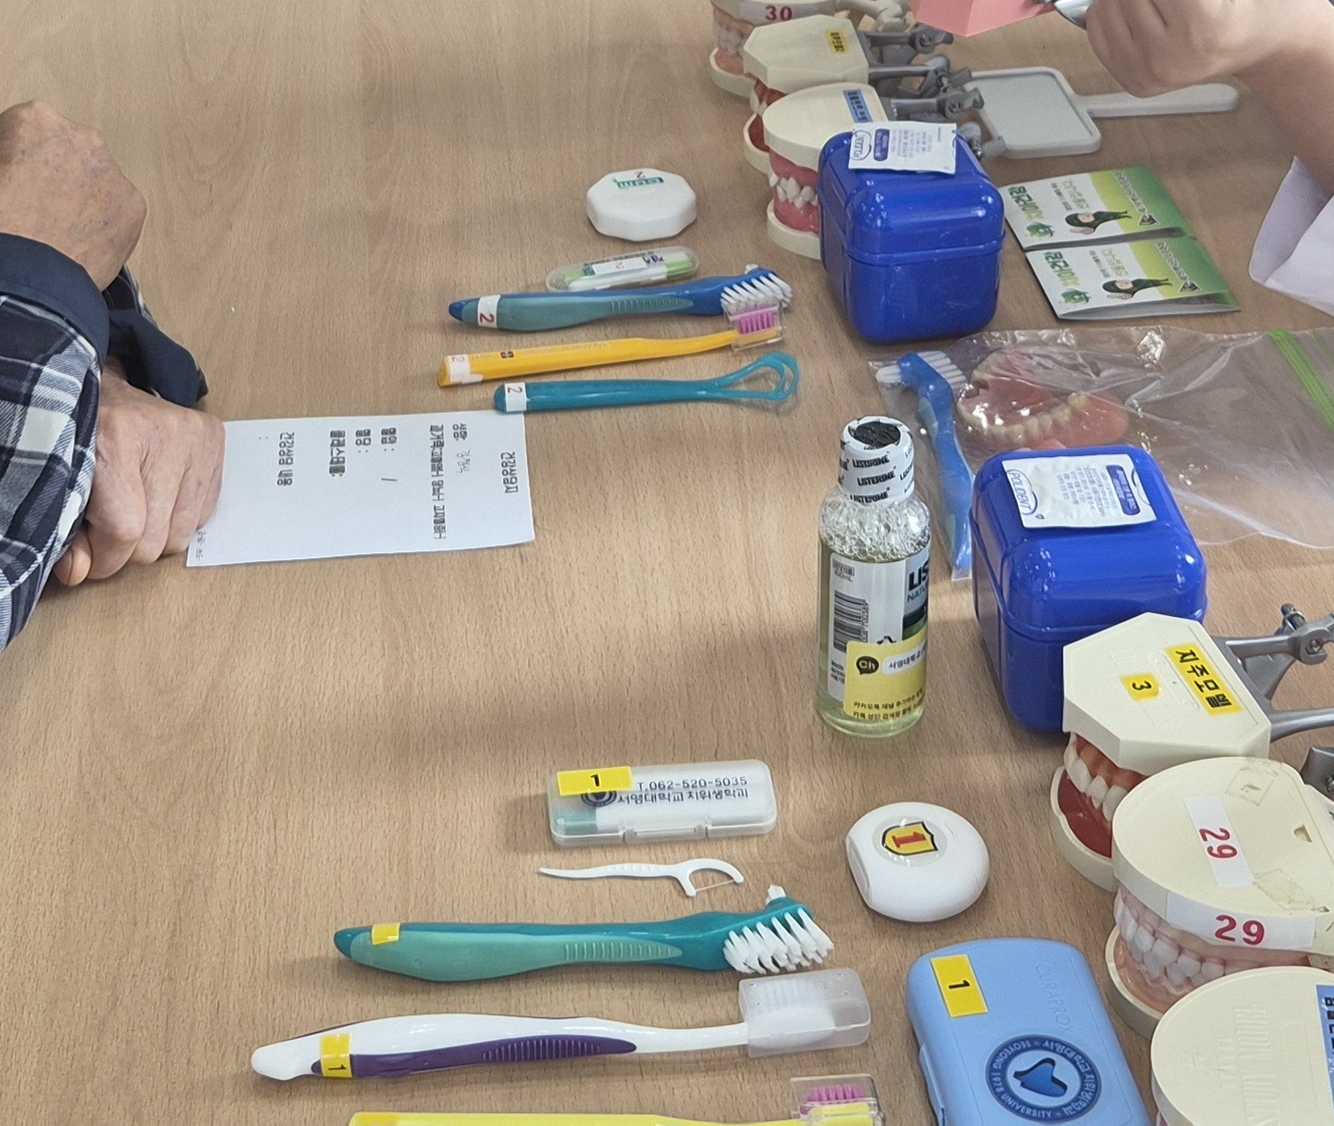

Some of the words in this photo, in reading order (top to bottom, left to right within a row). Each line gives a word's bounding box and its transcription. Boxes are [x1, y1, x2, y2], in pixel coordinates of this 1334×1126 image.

[765, 4, 794, 22] 30
[479, 312, 494, 324] 2
[507, 385, 523, 395] 2
[278, 431, 295, 467] 건강상담
[852, 454, 890, 468] LISTERINE
[278, 468, 294, 488] 내용
[500, 450, 518, 494] 건강상담지
[857, 469, 897, 487] LISTERINE
[850, 491, 891, 504] LISTERINE
[1130, 678, 1152, 694] 3
[1173, 648, 1233, 711] 지주모델
[590, 773, 600, 787] 1
[637, 776, 748, 792] T.062-520-5035
[617, 791, 685, 805] 서영대학교
[687, 788, 749, 801] 치위생학과
[1197, 826, 1238, 861] 29
[1213, 914, 1267, 945] 29
[948, 977, 971, 992] 1
[992, 1039, 1032, 1070] SEOYEONG
[1041, 1039, 1091, 1073] 서영대학교
[328, 1063, 347, 1072] 1
[991, 1072, 1005, 1093] 1978
[1062, 1074, 1097, 1116] 치위생학과
[1000, 1092, 1053, 1118] UNIVERSITY
